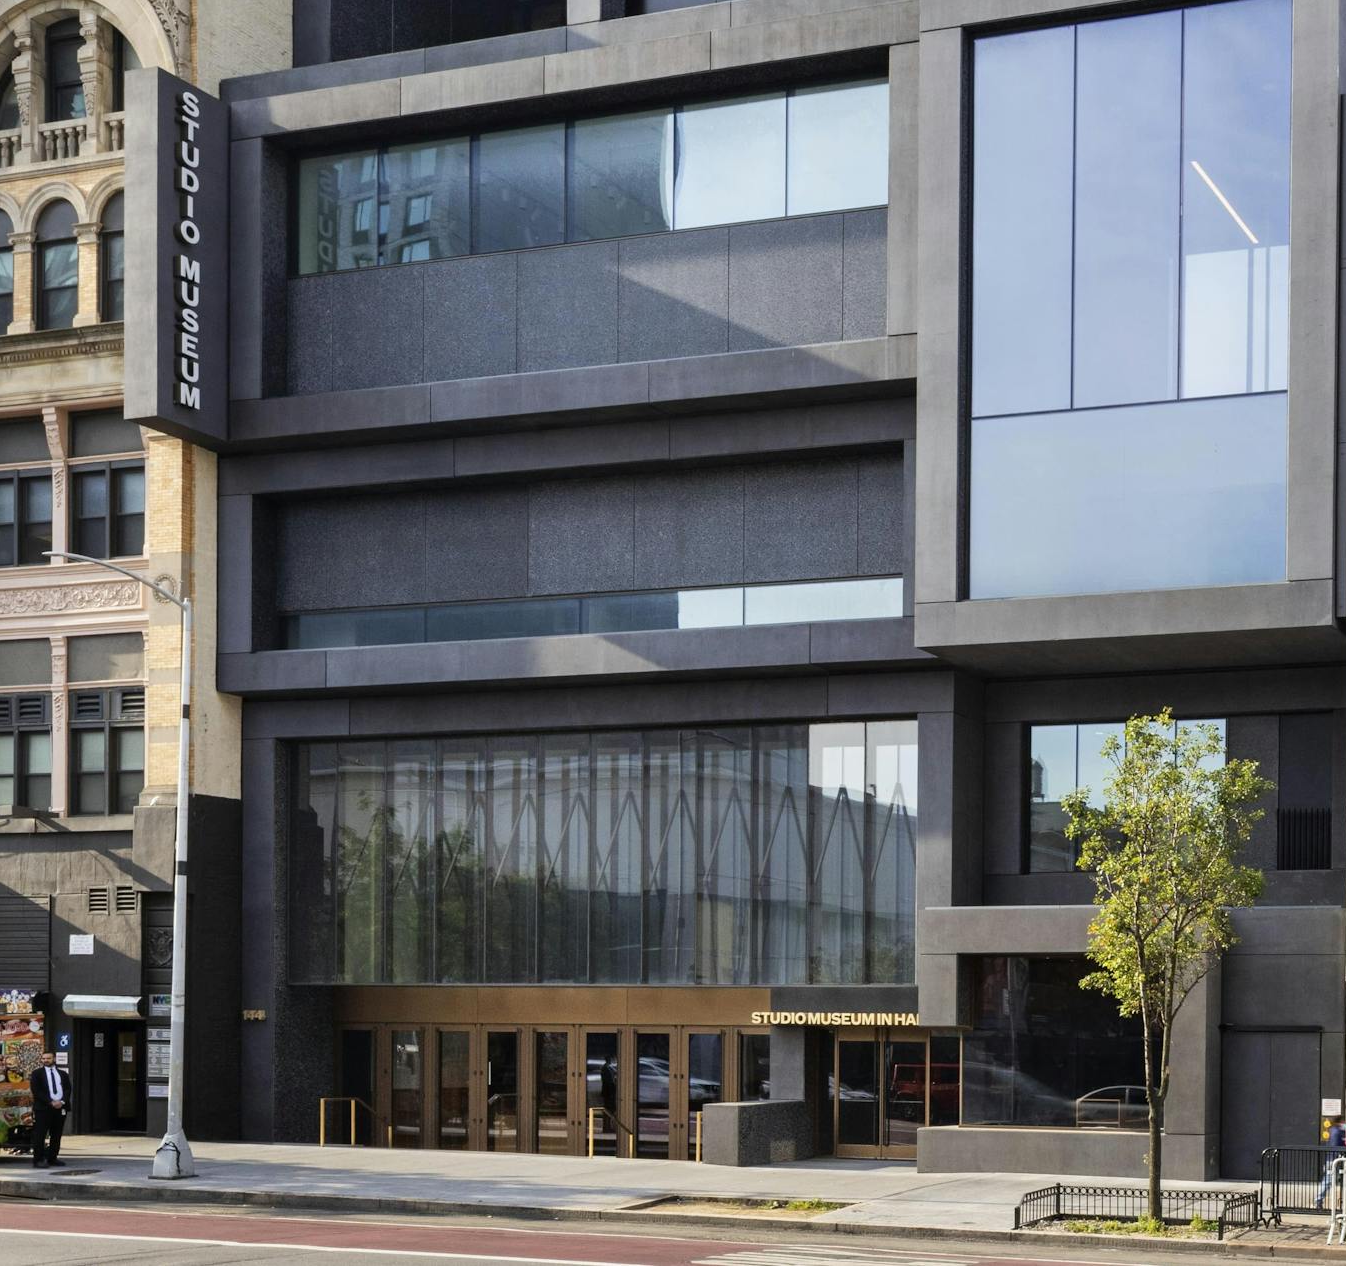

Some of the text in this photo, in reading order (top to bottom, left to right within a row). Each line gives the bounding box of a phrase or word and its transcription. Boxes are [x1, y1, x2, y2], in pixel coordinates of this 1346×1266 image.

[179, 91, 201, 410] STUDIO MUSEUM
[751, 1012, 806, 1025] STUDIO
[808, 1012, 877, 1026] MUSEUM
[877, 1013, 892, 1026] IN
